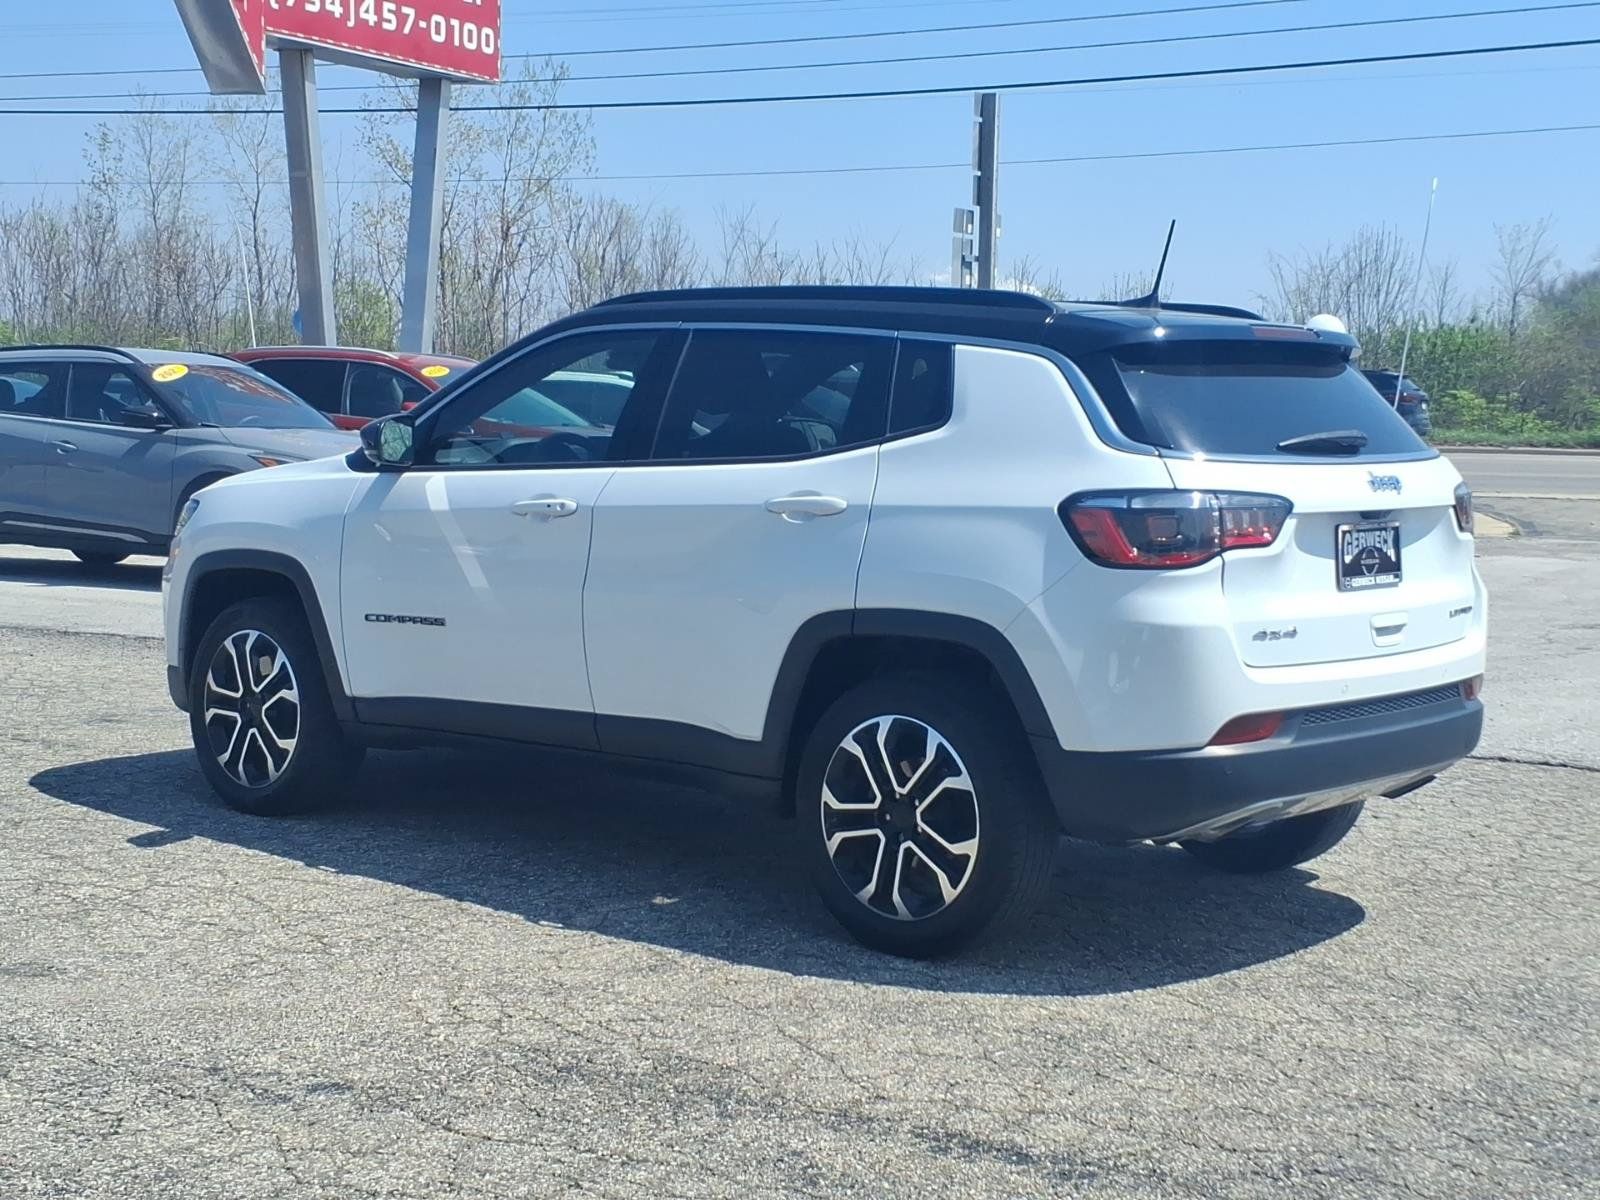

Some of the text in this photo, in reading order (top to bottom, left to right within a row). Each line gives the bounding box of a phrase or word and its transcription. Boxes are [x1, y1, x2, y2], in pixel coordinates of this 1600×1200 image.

[269, 0, 495, 55] 4)457-0100
[1343, 528, 1396, 564] GERWECK
[364, 613, 446, 627] COMPASS
